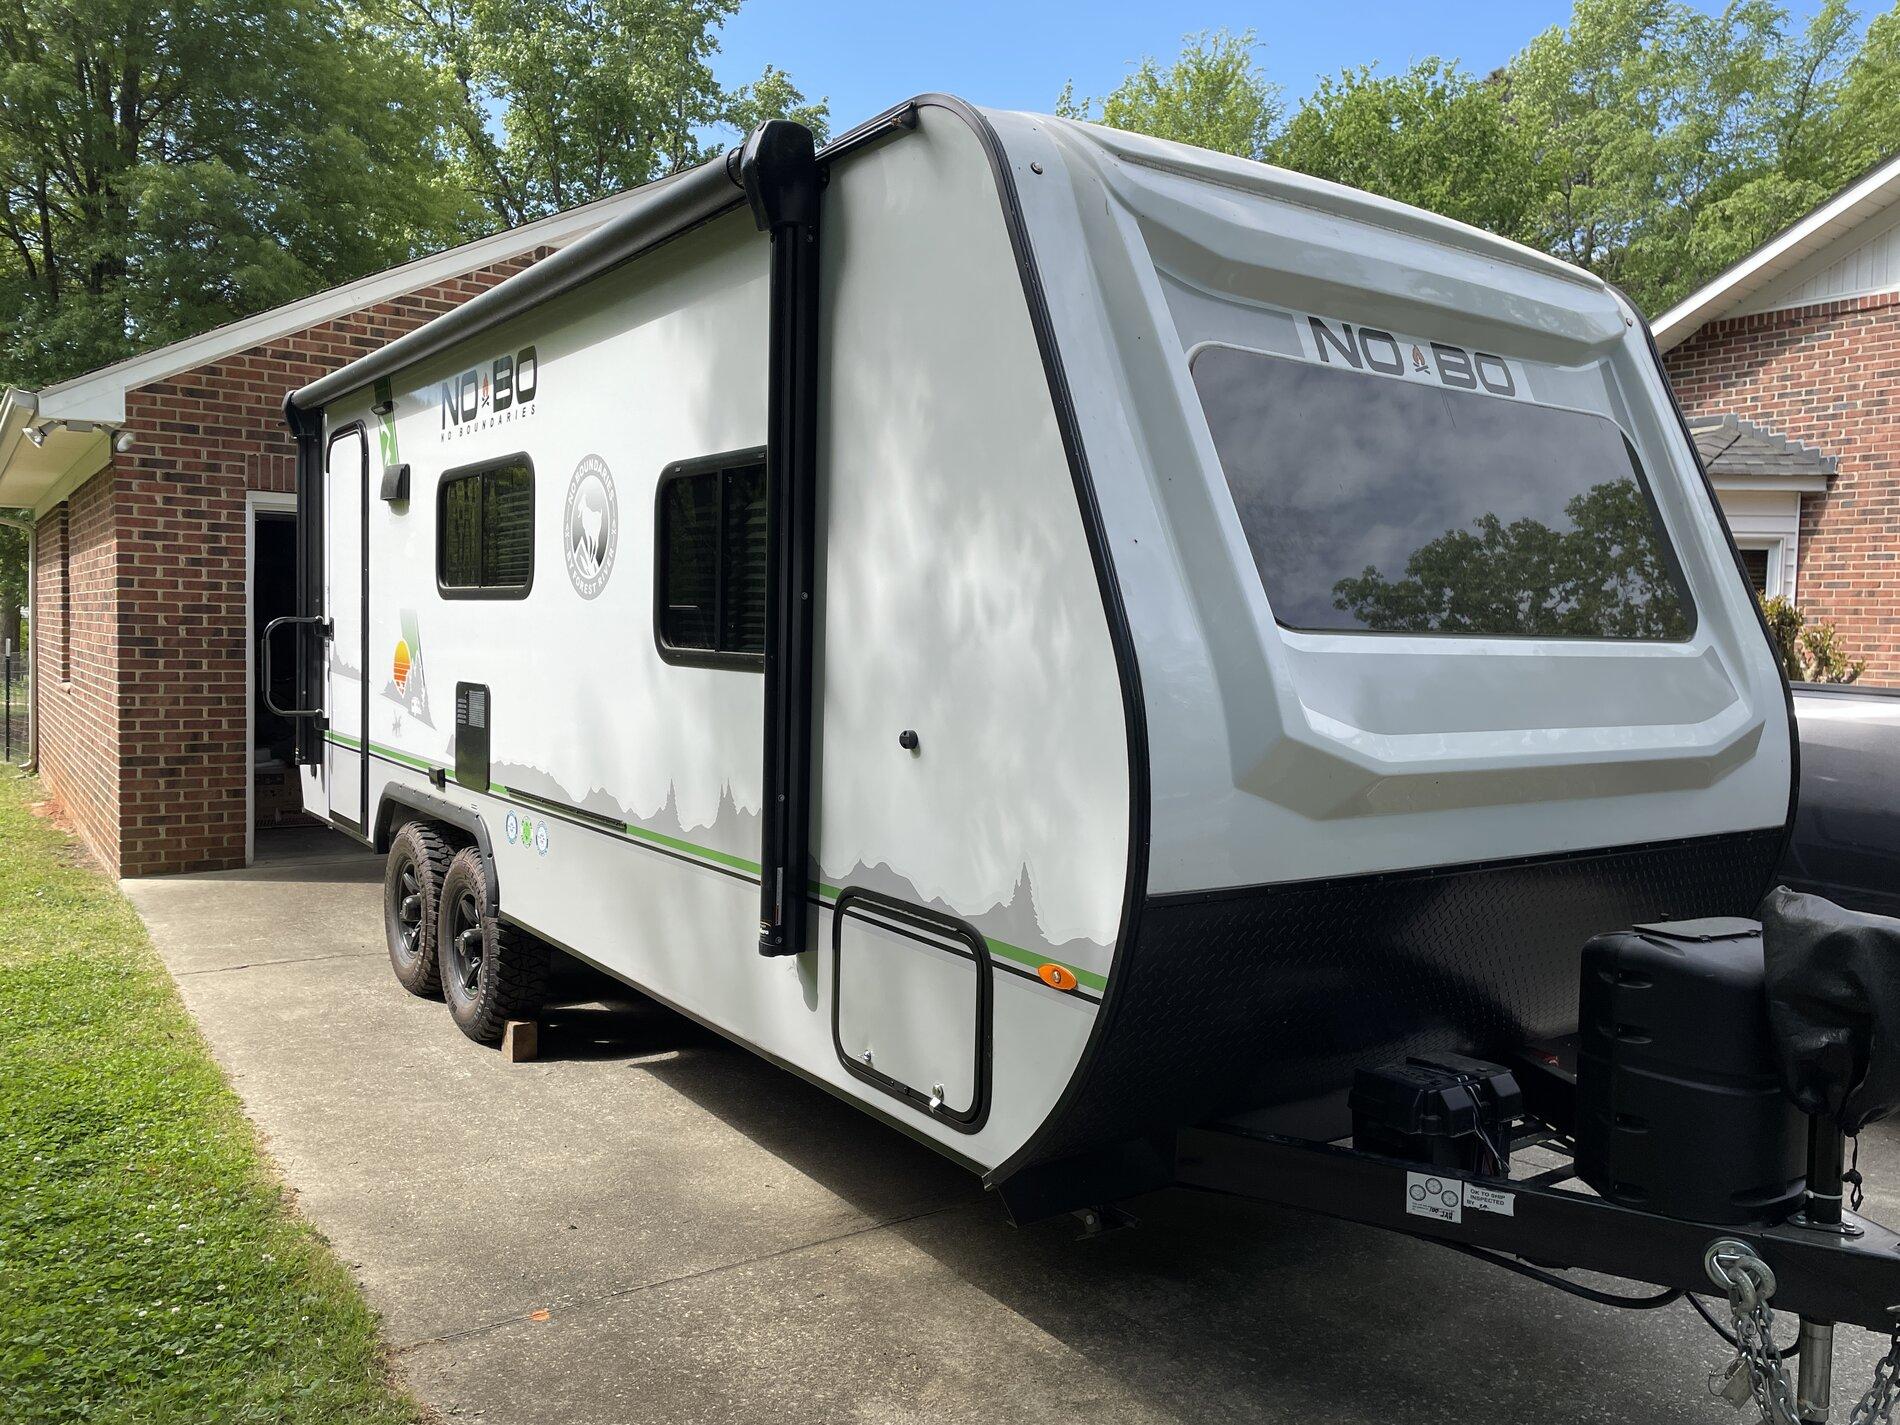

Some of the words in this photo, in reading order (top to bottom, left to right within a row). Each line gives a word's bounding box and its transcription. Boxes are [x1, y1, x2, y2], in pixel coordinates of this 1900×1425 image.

[440, 430, 452, 443] NO
[459, 403, 537, 438] BOUNDARIES
[567, 481, 577, 506] NO
[574, 457, 615, 502] BOUNDARIES
[572, 570, 598, 595] FOREST
[597, 547, 615, 588] RIVER
[1469, 1194, 1505, 1206] INSPECTED
[1481, 1190, 1490, 1198] TO
